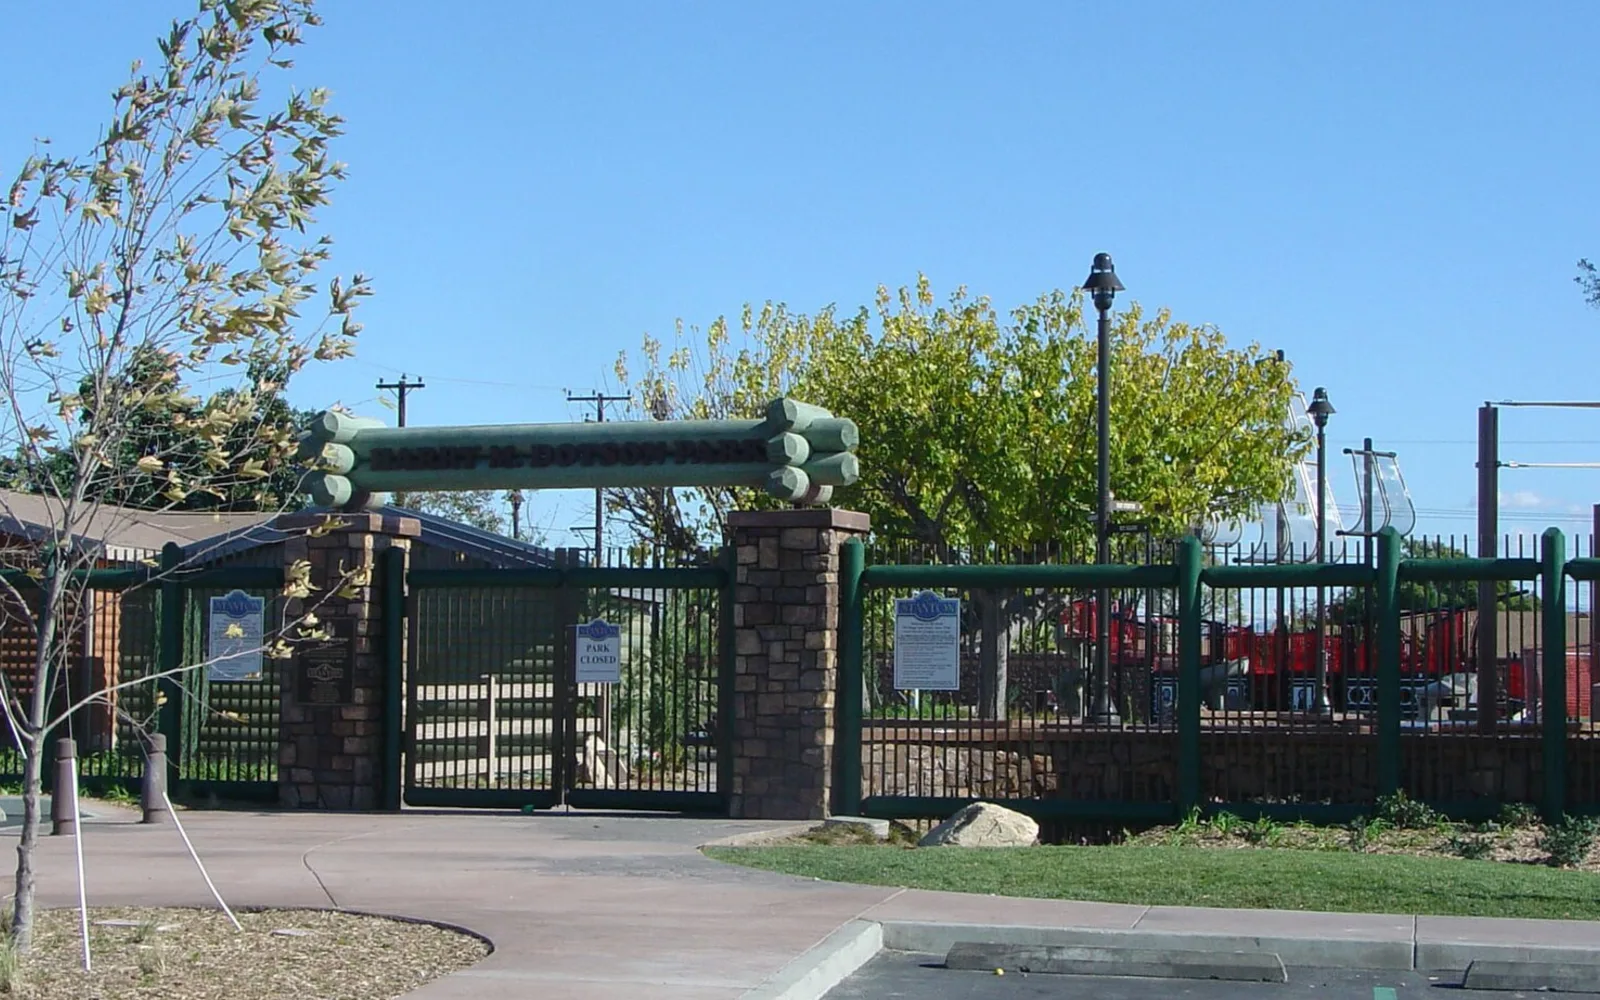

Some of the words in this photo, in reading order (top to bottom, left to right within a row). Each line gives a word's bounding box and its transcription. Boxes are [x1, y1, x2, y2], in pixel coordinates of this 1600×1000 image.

[489, 445, 524, 469] M.
[531, 442, 668, 468] DOTSON
[674, 439, 769, 464] PARK
[899, 602, 955, 614] STANTON
[586, 643, 610, 652] PARK
[580, 655, 616, 664] CLOSED
